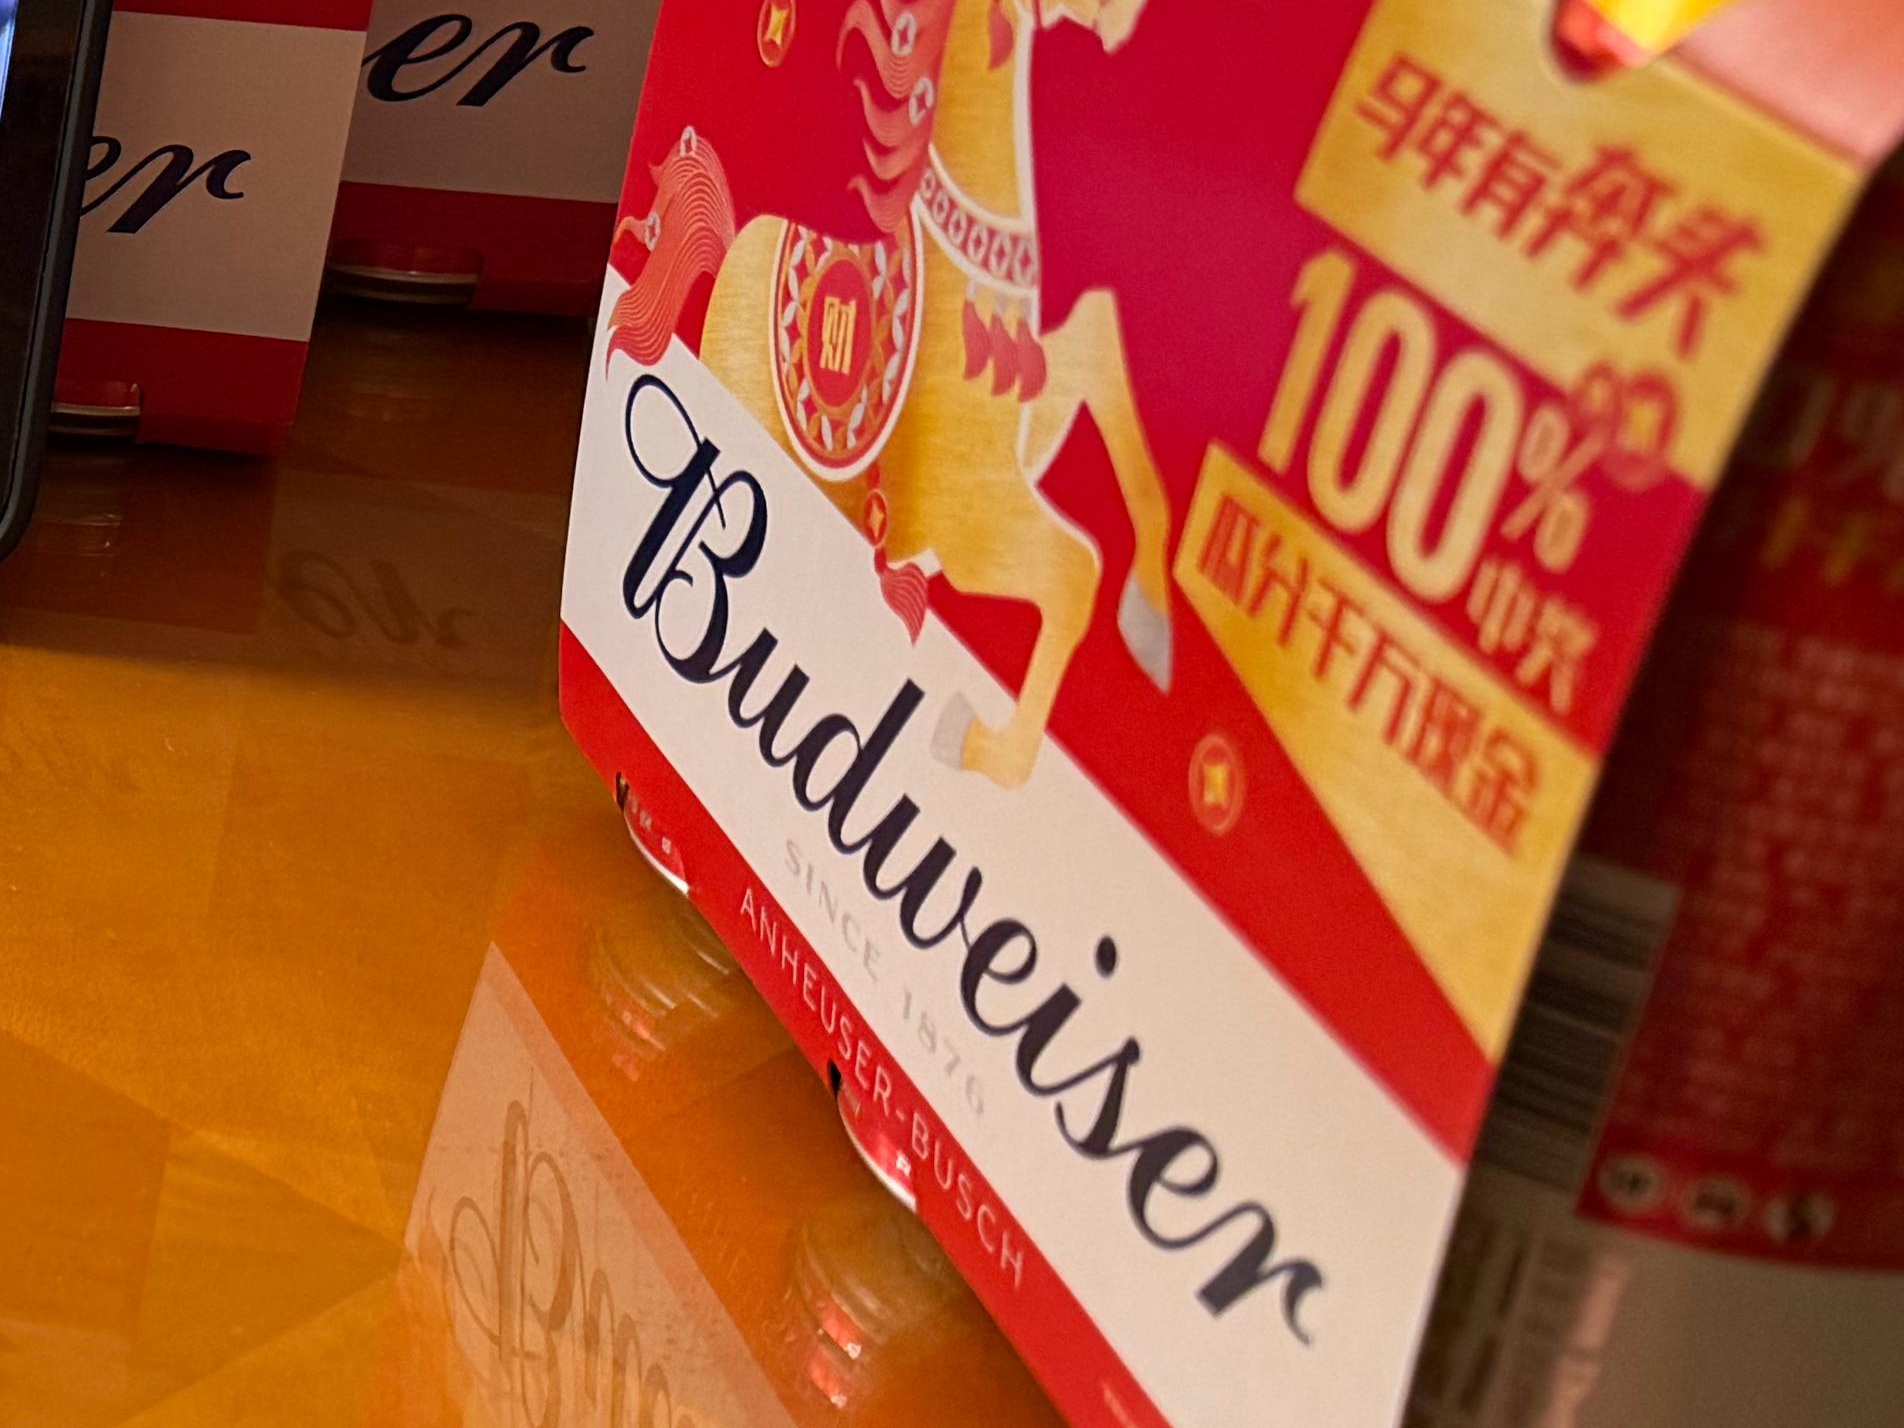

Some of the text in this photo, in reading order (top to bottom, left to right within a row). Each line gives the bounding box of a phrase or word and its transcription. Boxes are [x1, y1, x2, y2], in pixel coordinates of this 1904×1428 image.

[1256, 246, 1590, 605] 100%
[623, 372, 1328, 1347] Budweiser
[782, 838, 988, 1120] SINCE 1876
[737, 886, 1029, 1290] ANHEUSER-BUSCH
